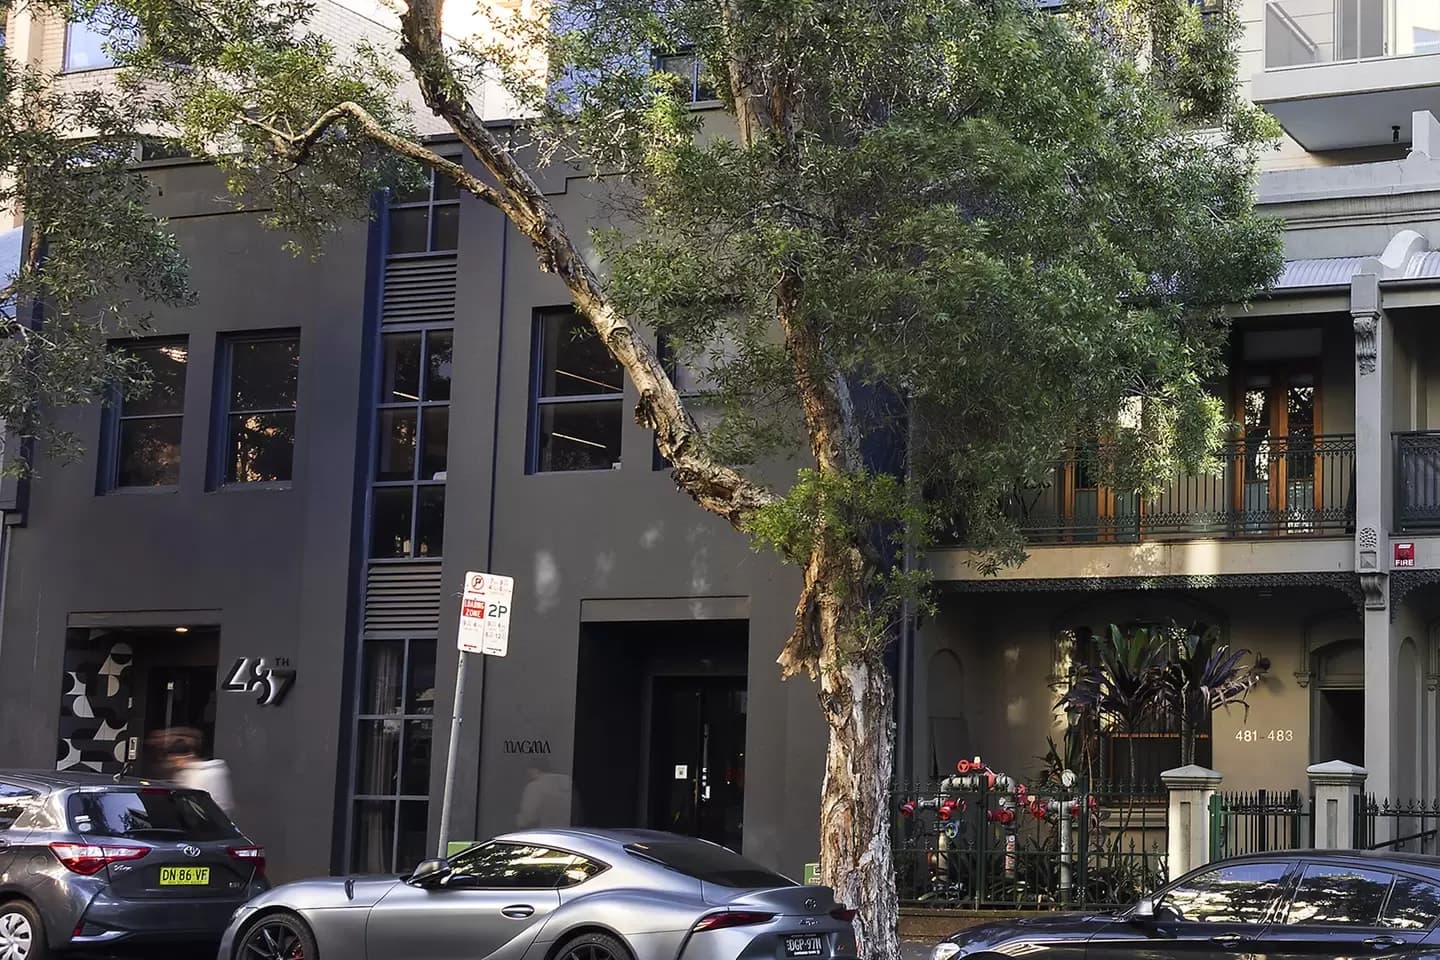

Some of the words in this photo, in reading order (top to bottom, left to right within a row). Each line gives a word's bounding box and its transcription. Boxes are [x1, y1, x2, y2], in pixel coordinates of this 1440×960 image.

[488, 604, 508, 618] 2P
[275, 658, 289, 666] TH
[503, 740, 551, 753] MAGMA
[162, 869, 176, 880] DN
[179, 869, 192, 880] 86
